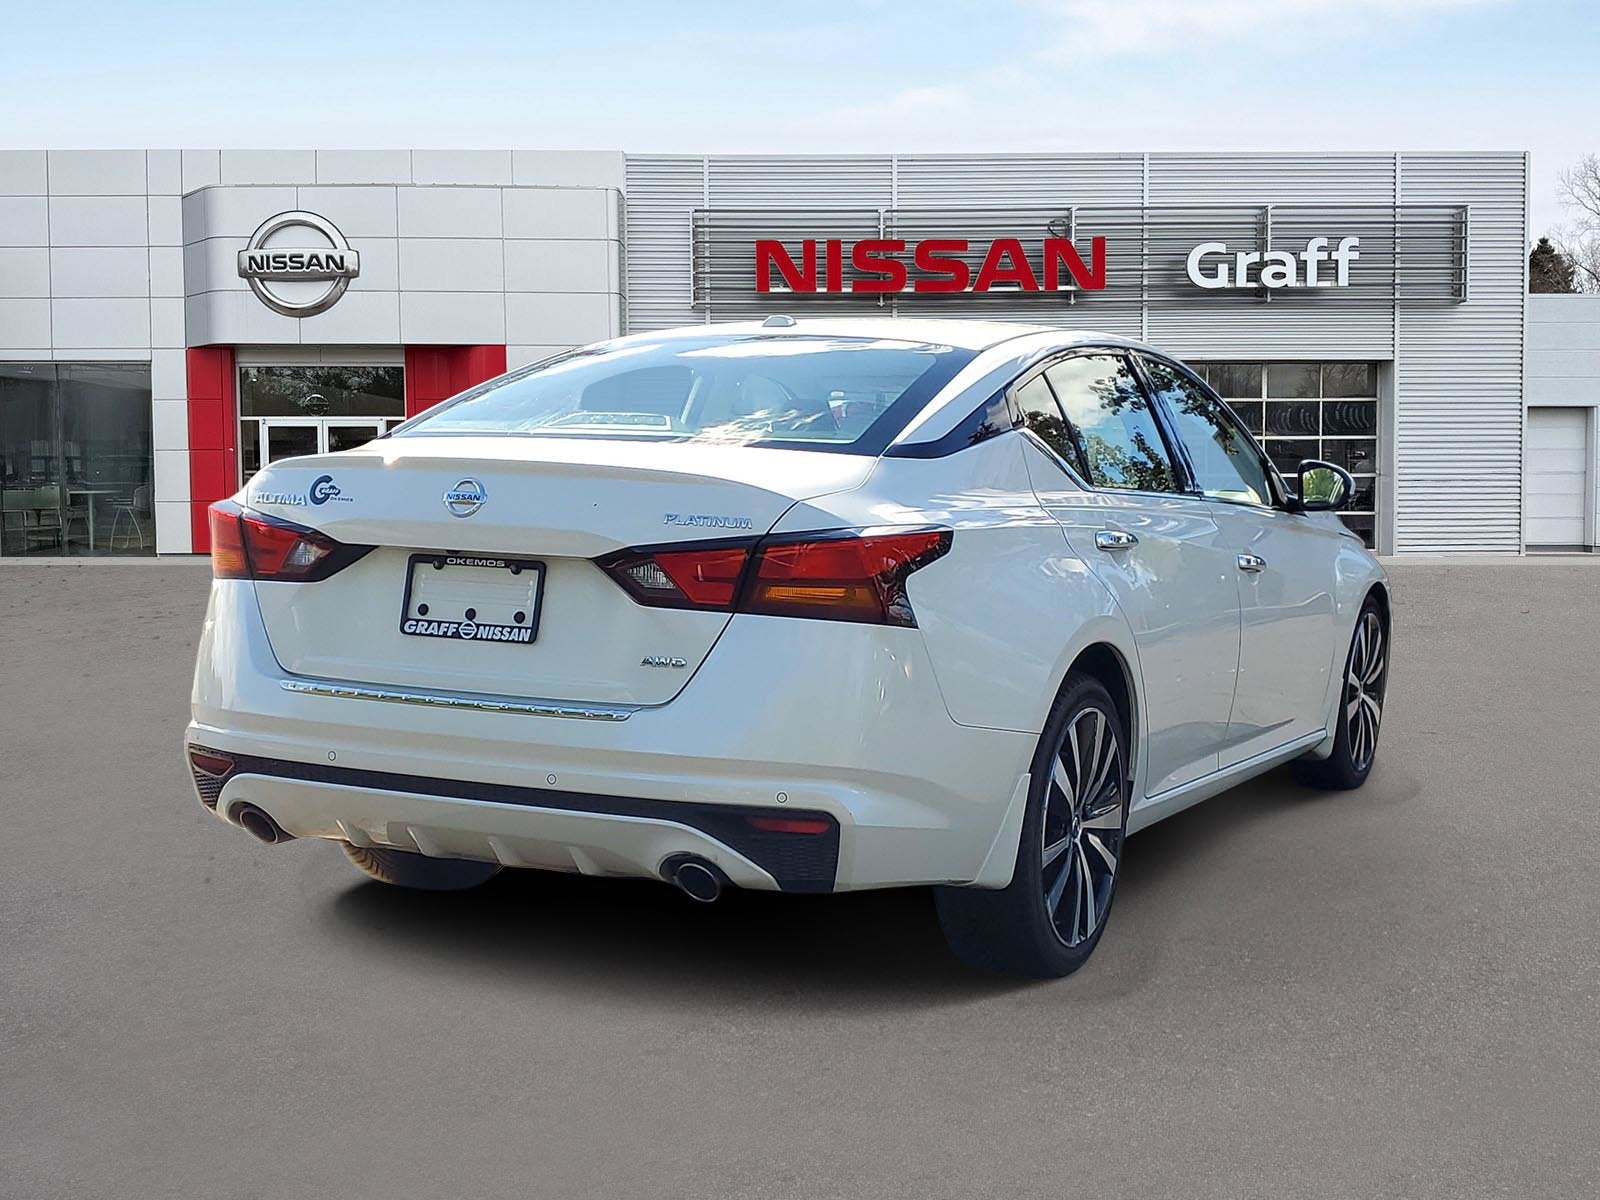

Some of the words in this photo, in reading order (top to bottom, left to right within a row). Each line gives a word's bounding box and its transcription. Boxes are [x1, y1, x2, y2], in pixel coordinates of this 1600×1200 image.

[247, 253, 345, 272] NISSAN
[755, 236, 1107, 293] NISSAN
[1186, 237, 1360, 289] Graff
[254, 491, 308, 507] ALTIMA
[447, 493, 481, 501] NISSAN
[663, 513, 753, 530] PLATINUM
[446, 557, 506, 567] OKEMOS
[403, 620, 459, 637] GRAFF
[476, 625, 532, 642] NISSAN
[640, 655, 688, 668] AWD
